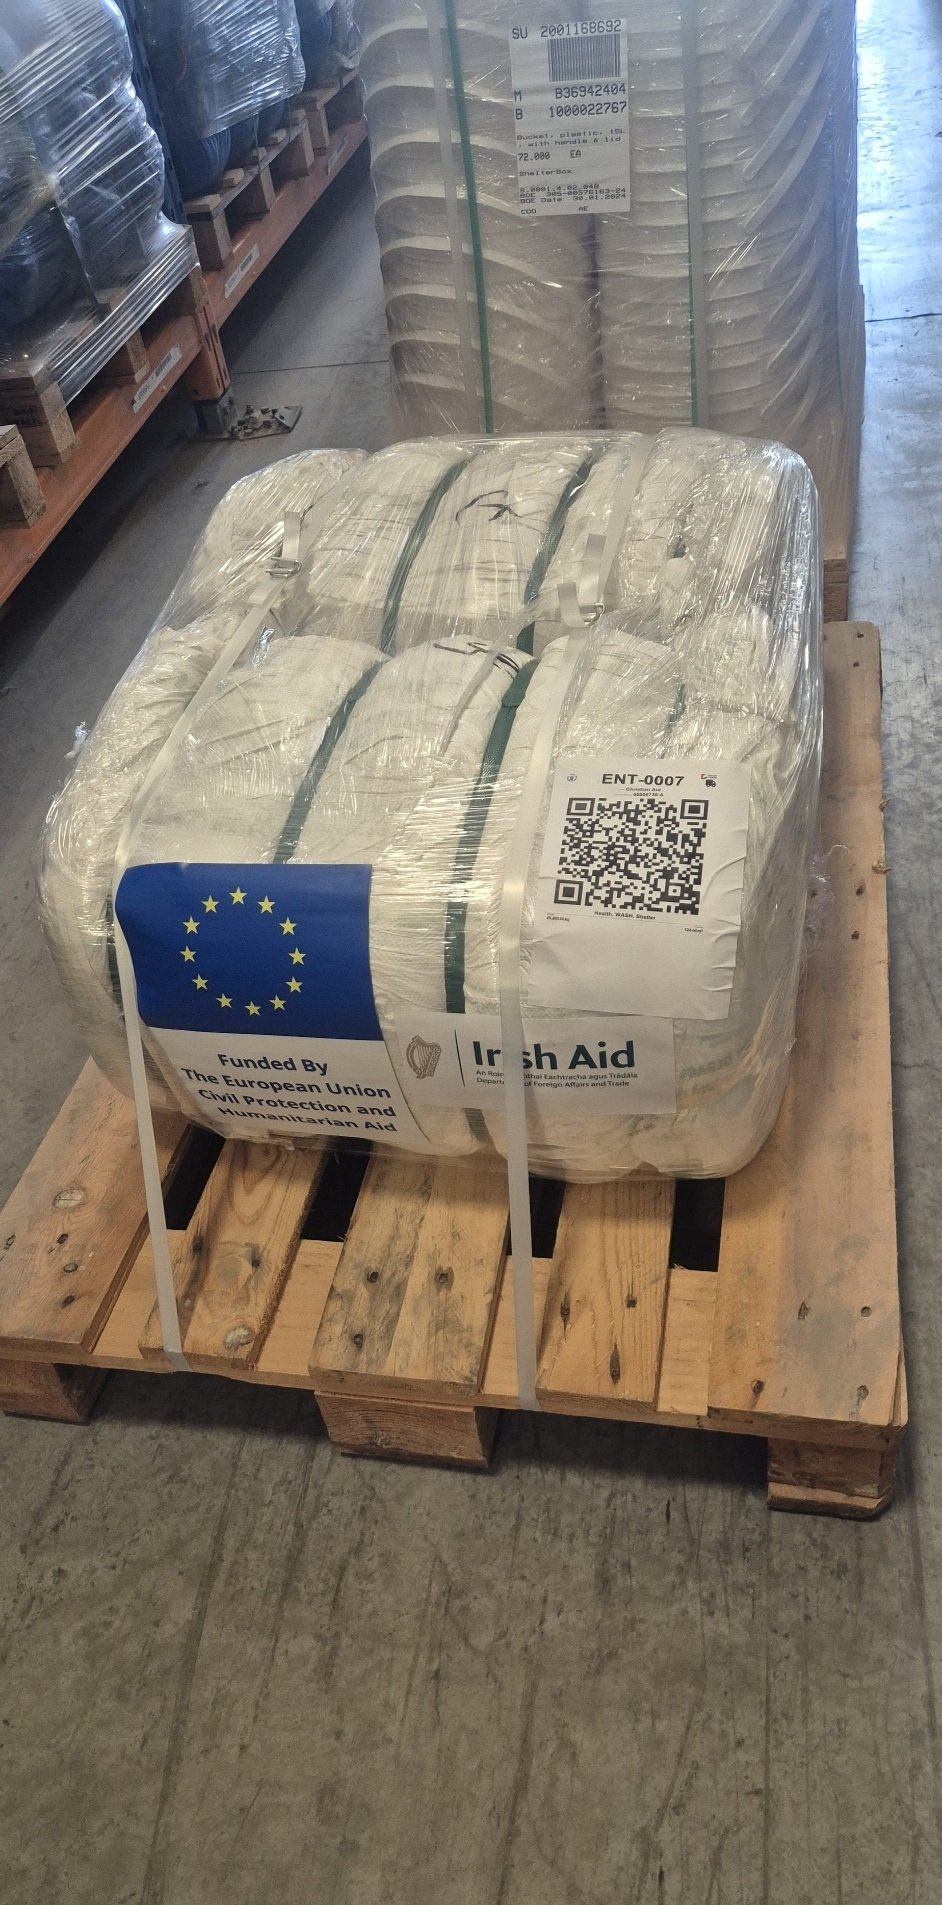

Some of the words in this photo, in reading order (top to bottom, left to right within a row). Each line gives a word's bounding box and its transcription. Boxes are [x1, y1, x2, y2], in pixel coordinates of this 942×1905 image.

[512, 27, 528, 40] SU
[540, 20, 621, 37] 2001168692
[514, 90, 522, 102] M
[555, 83, 626, 99] B36942404
[516, 108, 523, 120] B
[549, 101, 627, 117] 1000022767
[570, 149, 582, 158] EA
[519, 169, 572, 177] ShelterBox
[601, 773, 685, 787] ENT-0007
[594, 910, 614, 918] Health,
[217, 1053, 297, 1072] Funded
[301, 1059, 328, 1076] By
[472, 1041, 558, 1070] Irsh
[568, 1040, 635, 1070] Aid
[181, 1067, 224, 1084] The
[223, 1075, 321, 1093] European
[326, 1082, 391, 1099] Union
[533, 1081, 563, 1089] Foreign
[198, 1089, 240, 1104] Civil
[243, 1095, 352, 1113] Protection
[357, 1106, 398, 1117] and
[218, 1107, 359, 1128] Humanitarian
[364, 1121, 399, 1132] Aid
